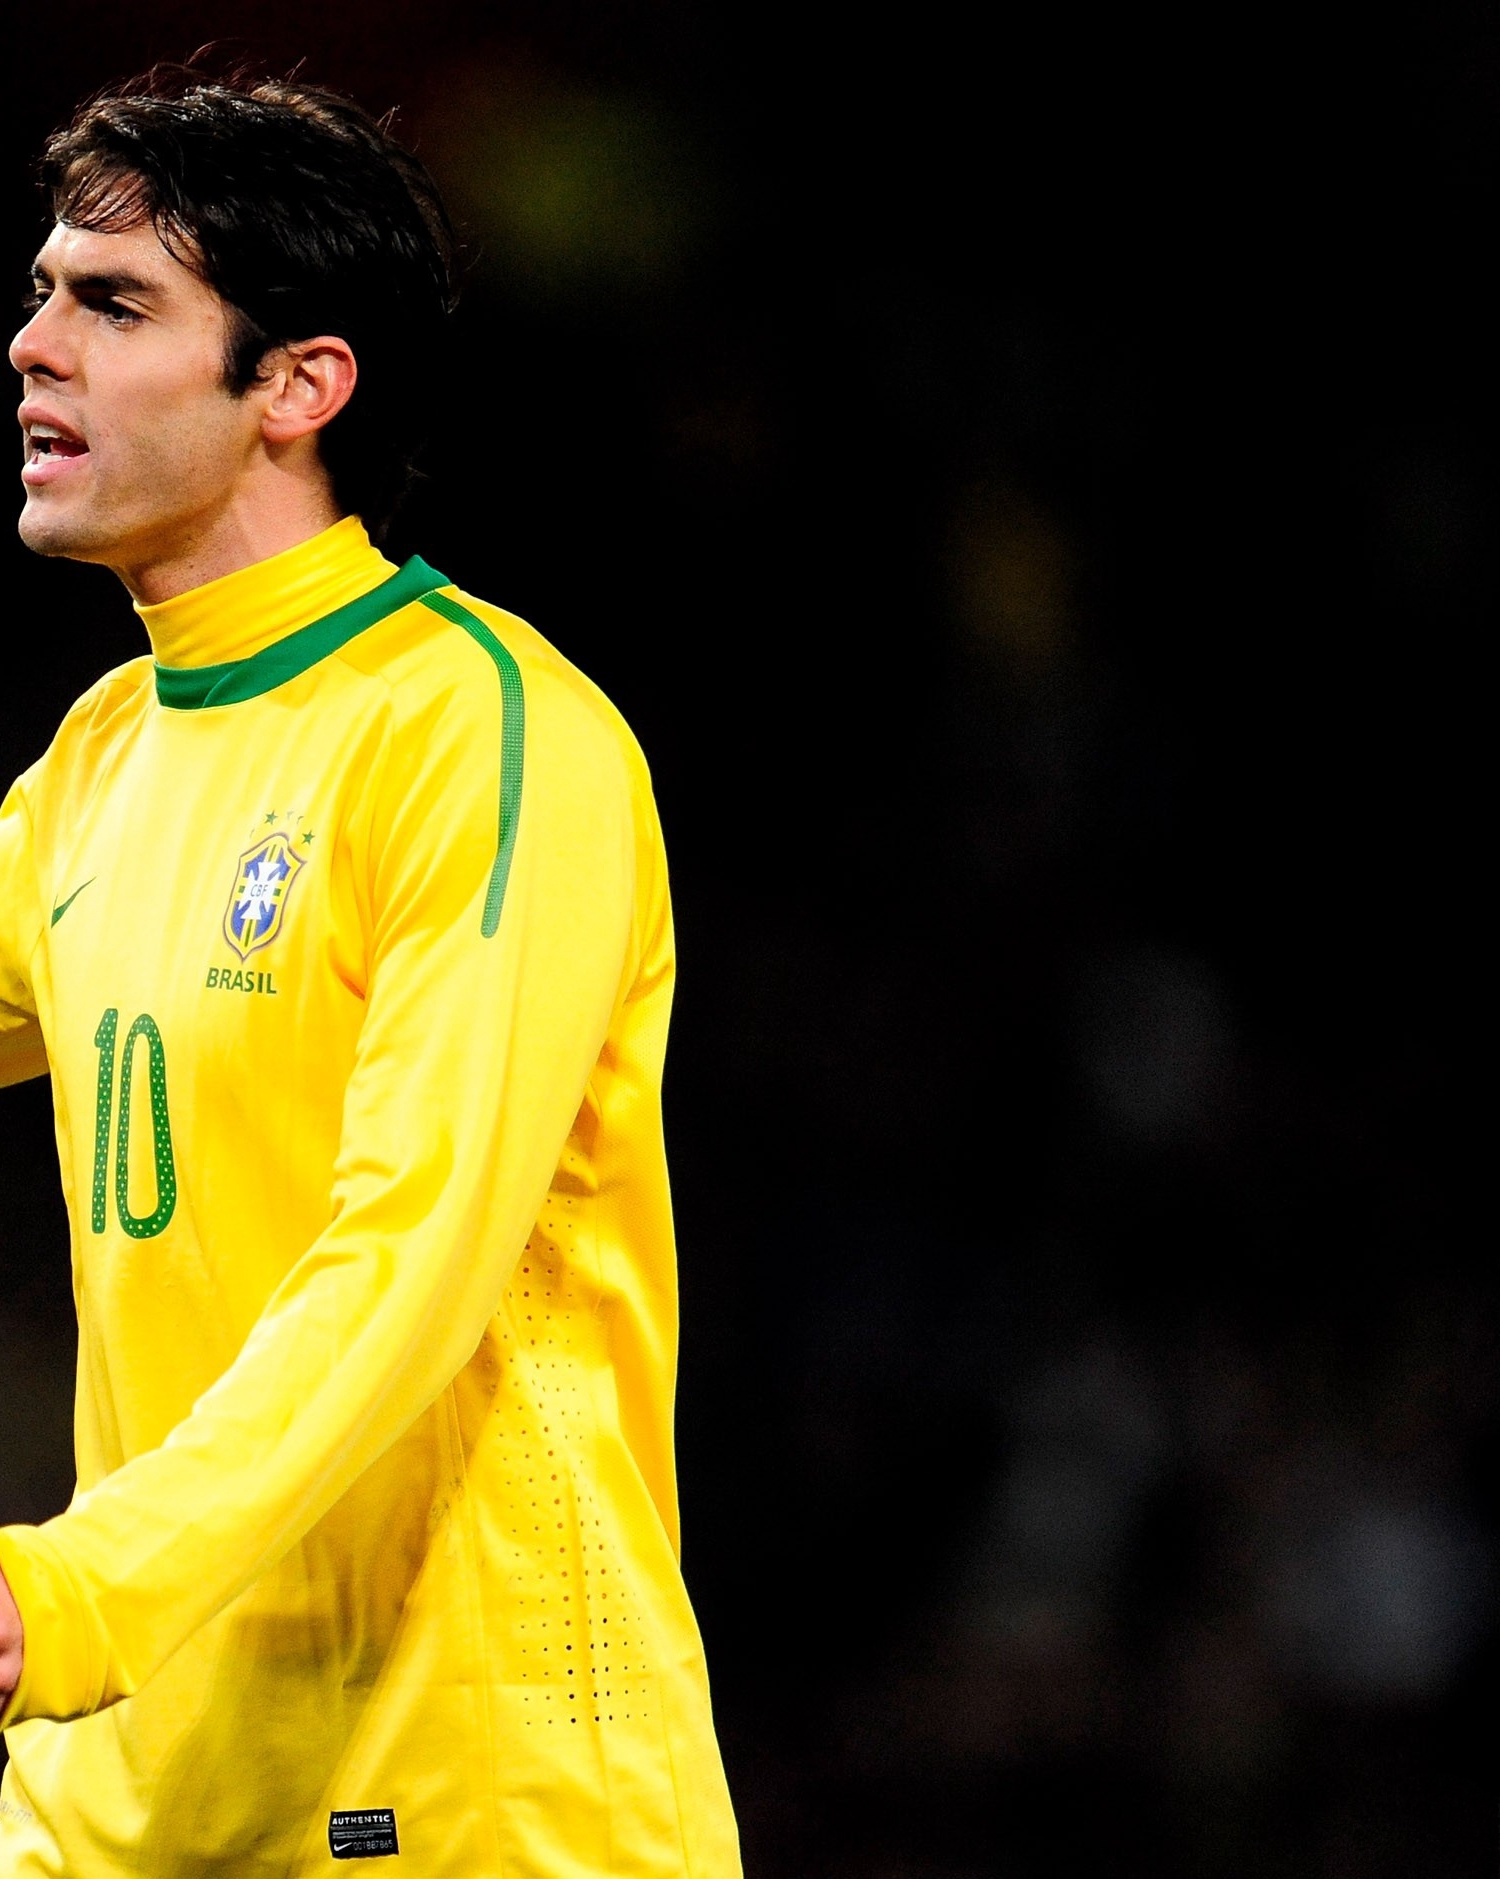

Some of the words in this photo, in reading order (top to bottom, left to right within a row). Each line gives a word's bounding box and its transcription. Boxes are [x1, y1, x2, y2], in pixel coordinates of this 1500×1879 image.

[250, 883, 268, 898] CBF
[206, 967, 277, 994] BRASIL
[92, 1008, 177, 1239] 10
[332, 1814, 391, 1826] AUTHENTIC
